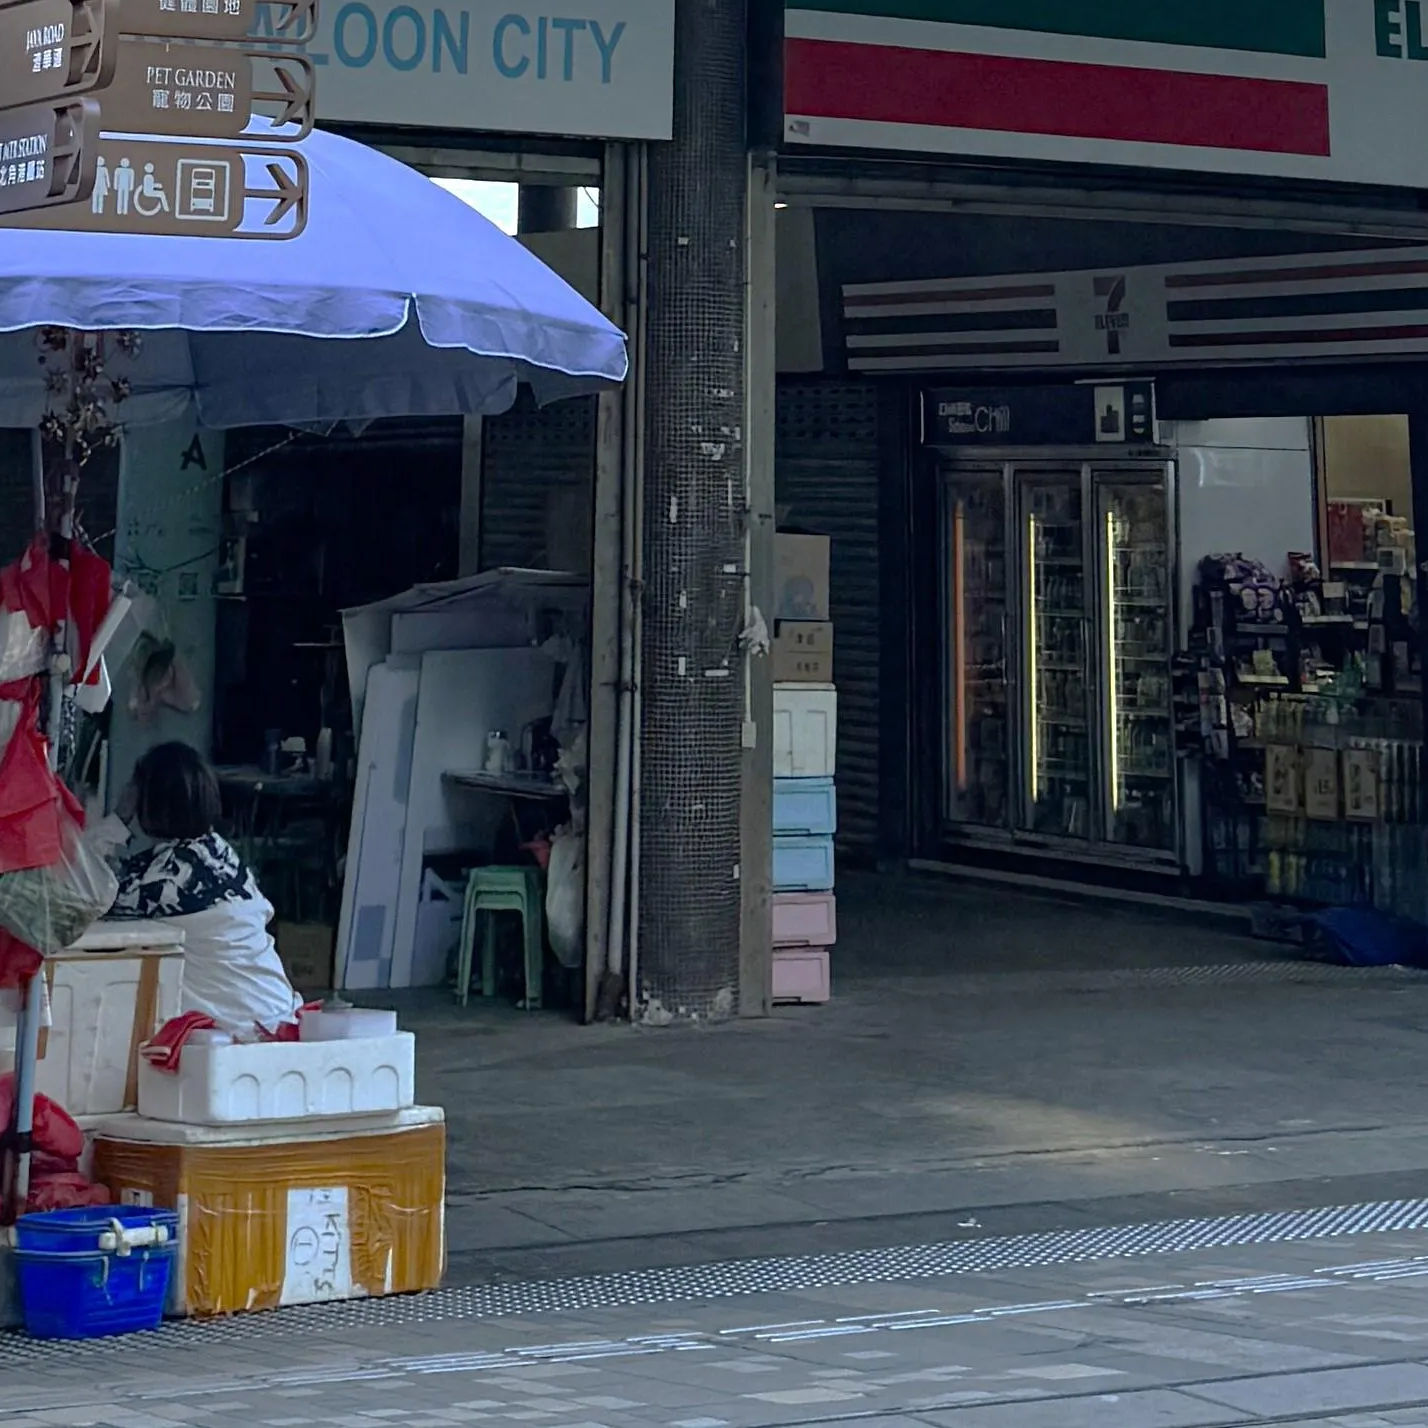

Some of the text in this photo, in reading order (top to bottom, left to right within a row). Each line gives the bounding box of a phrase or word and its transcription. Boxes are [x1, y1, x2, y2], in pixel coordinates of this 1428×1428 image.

[492, 14, 627, 84] CITY
[146, 66, 236, 90] PET GARDEN
